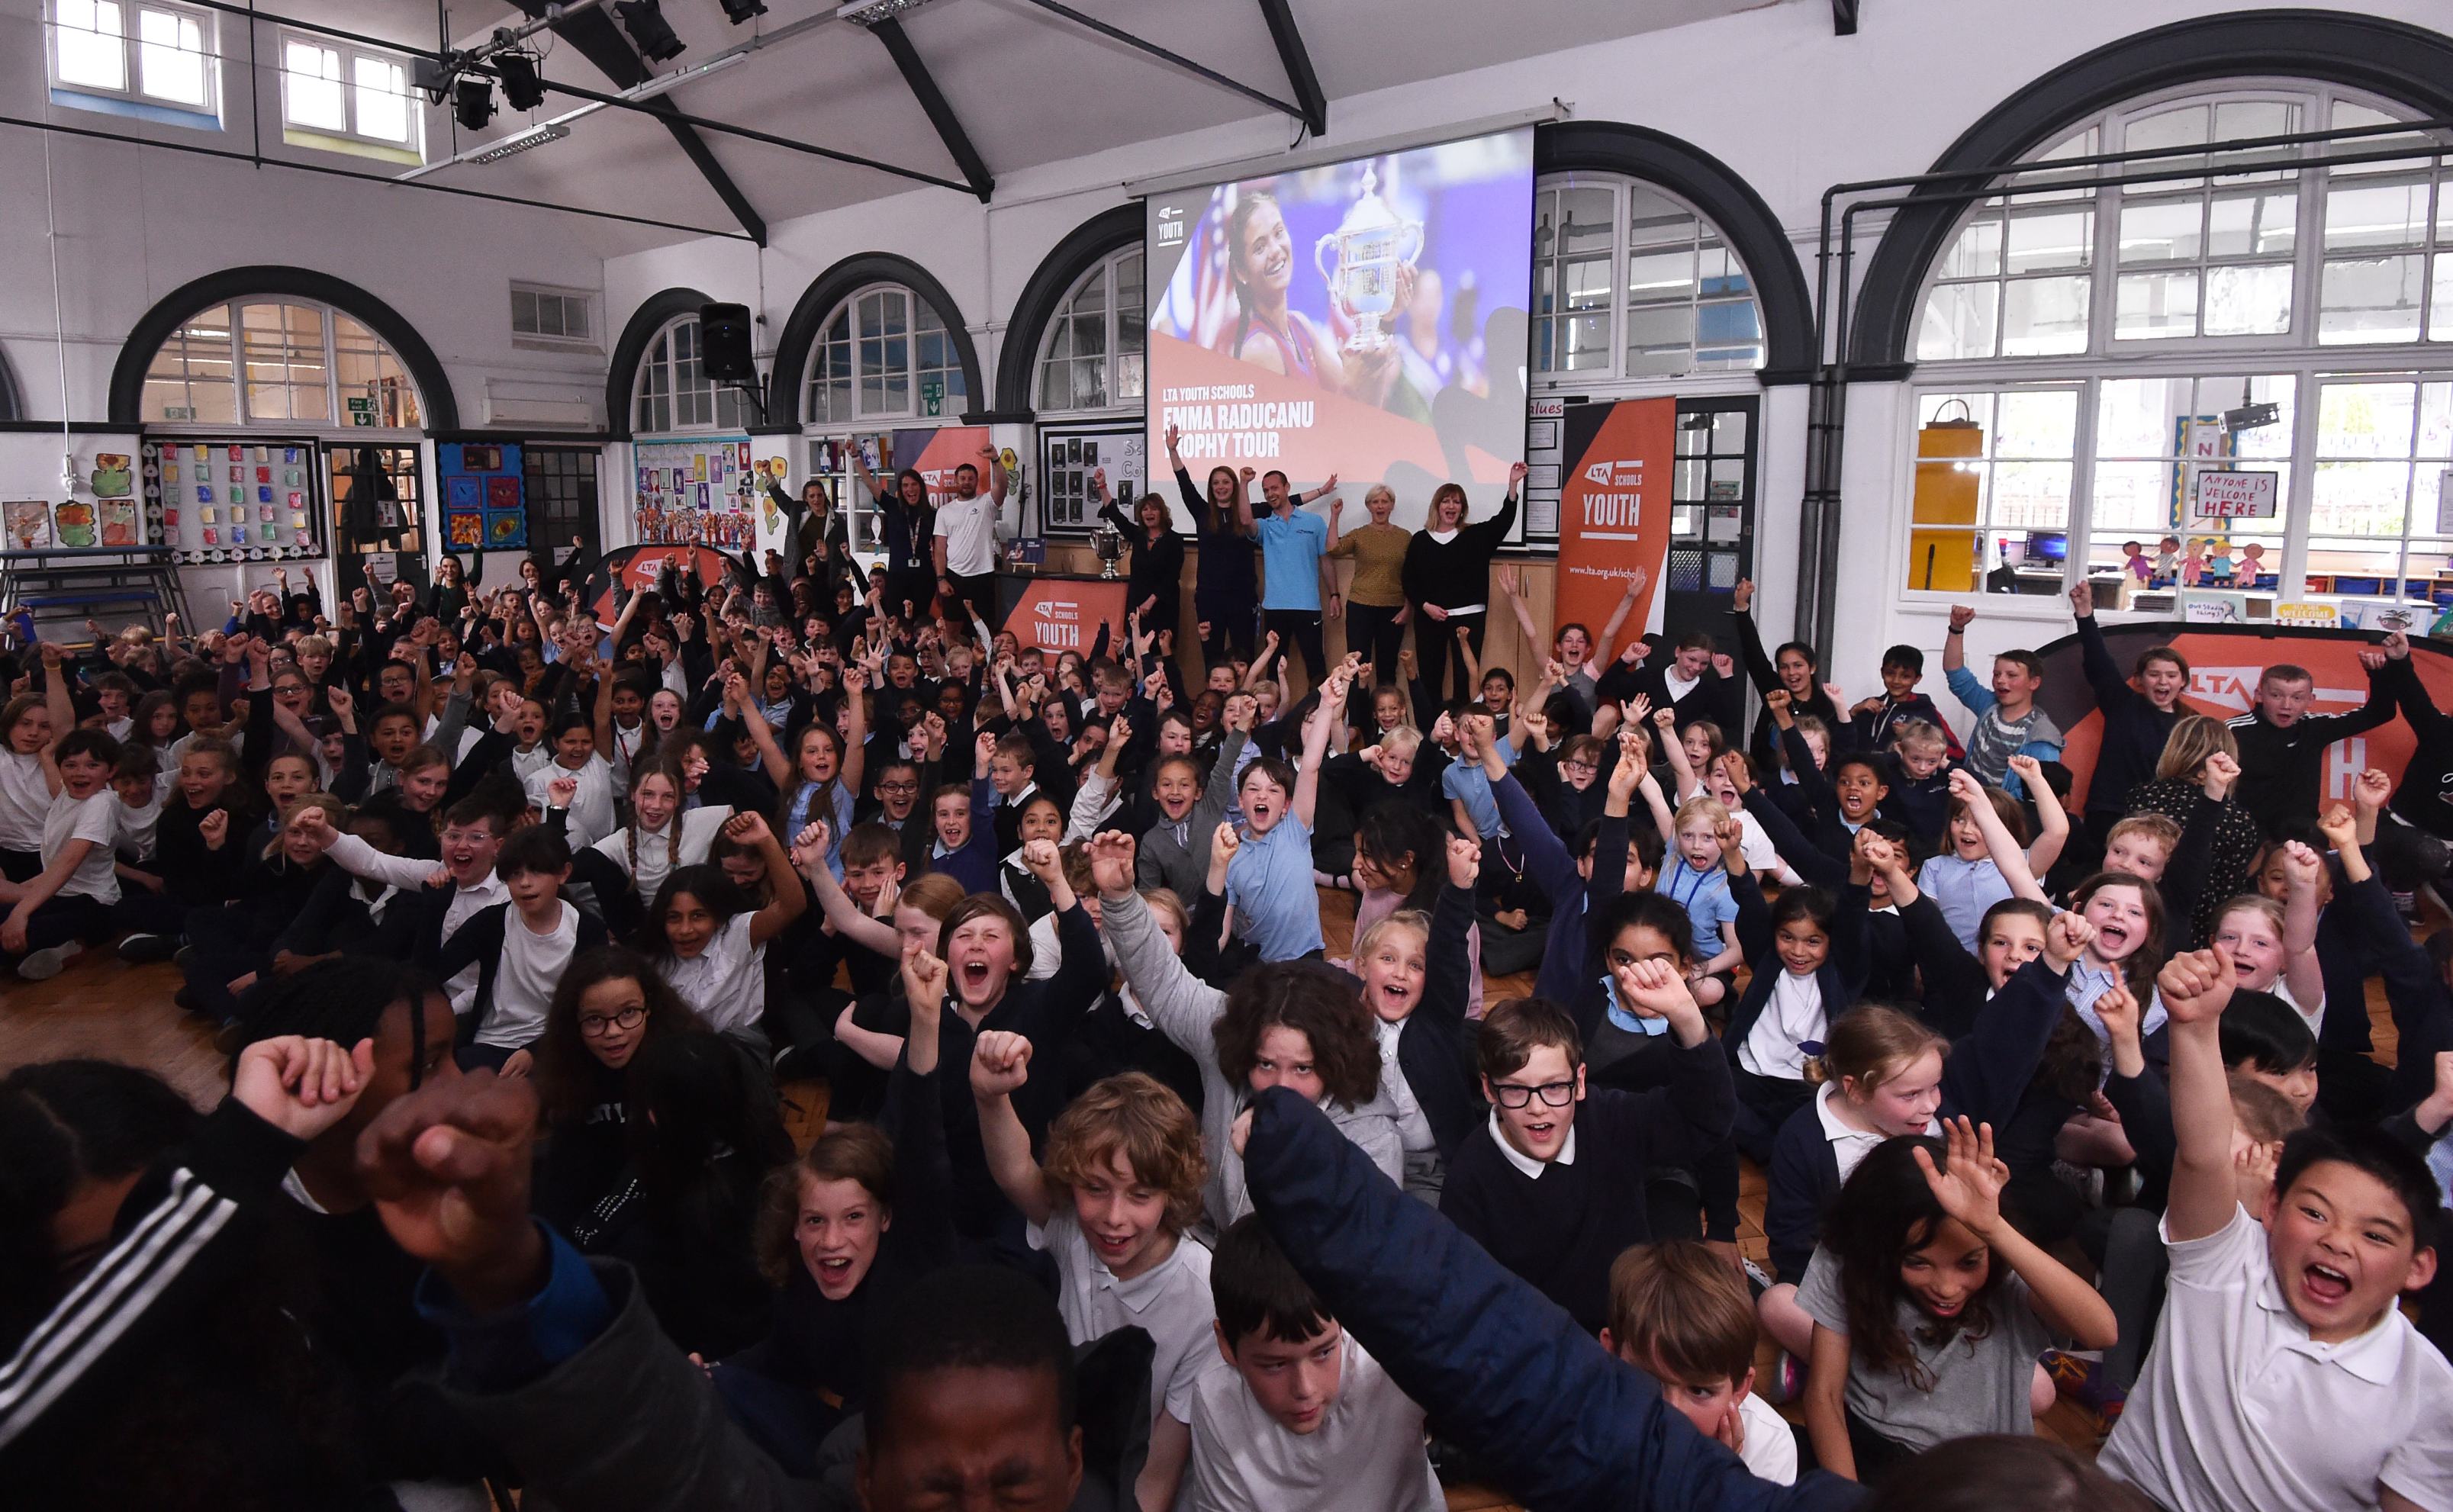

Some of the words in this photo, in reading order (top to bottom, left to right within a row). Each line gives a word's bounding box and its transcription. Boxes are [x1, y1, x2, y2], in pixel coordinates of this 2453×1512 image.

[1158, 220, 1183, 240] YOUTH
[1163, 388, 1178, 402] LTA
[1180, 386, 1209, 401] YOUTH
[1211, 384, 1255, 401] SCHOOLS
[1530, 401, 1562, 414] alues
[1163, 405, 1214, 431] EMMA
[1218, 401, 1315, 429] RADUCANU
[1233, 431, 1280, 458] TOUR
[1591, 468, 1610, 484] LTA
[1614, 475, 1642, 486] SCHOOLS
[2204, 475, 2248, 488] ANYONE
[2205, 487, 2255, 501] WELCOME
[1583, 494, 1640, 526] YOUTH
[2204, 500, 2258, 516] HERE
[1039, 605, 1051, 615] LTA
[1055, 611, 1078, 619] SCHOOLS
[1035, 621, 1079, 647] YOUTH
[2191, 674, 2255, 710] LTA
